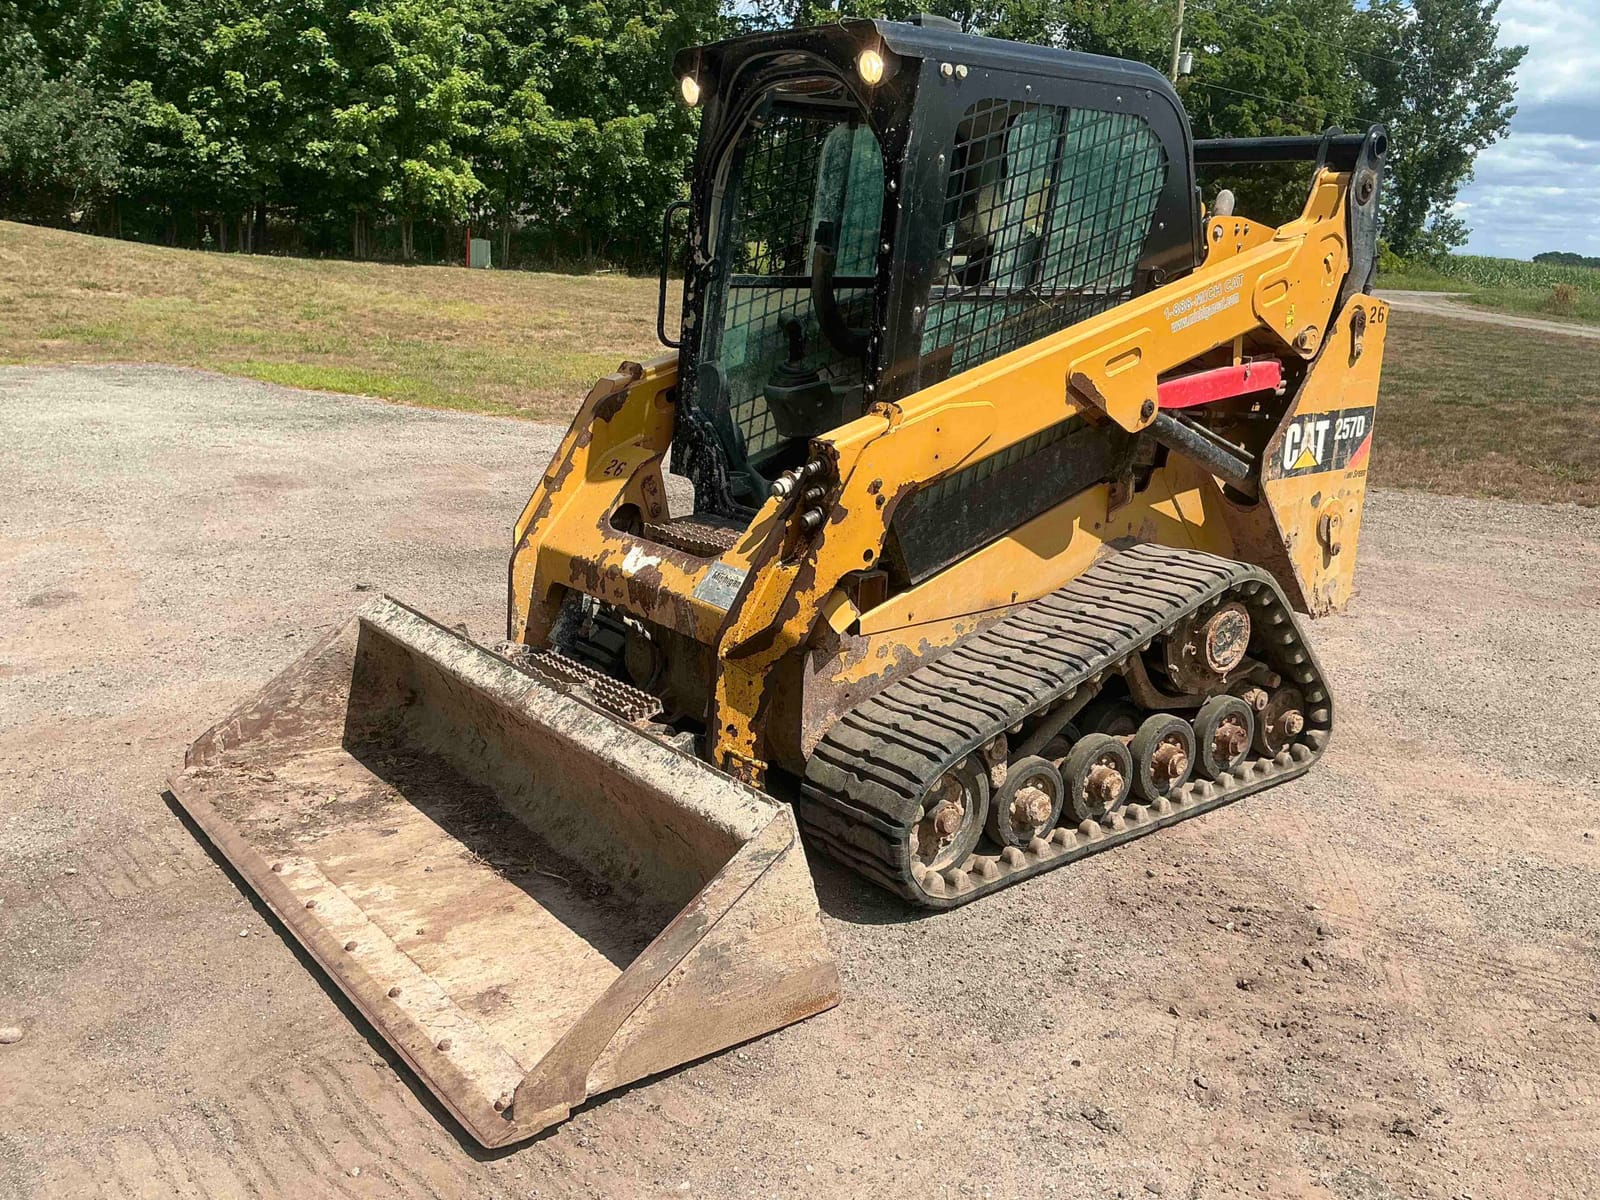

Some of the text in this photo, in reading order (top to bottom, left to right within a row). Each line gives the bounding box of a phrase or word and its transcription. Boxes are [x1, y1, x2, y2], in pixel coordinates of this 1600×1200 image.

[1224, 273, 1244, 293] CAT
[1369, 305, 1385, 324] 26
[1283, 415, 1366, 470] CAT 257D
[603, 459, 627, 477] 26
